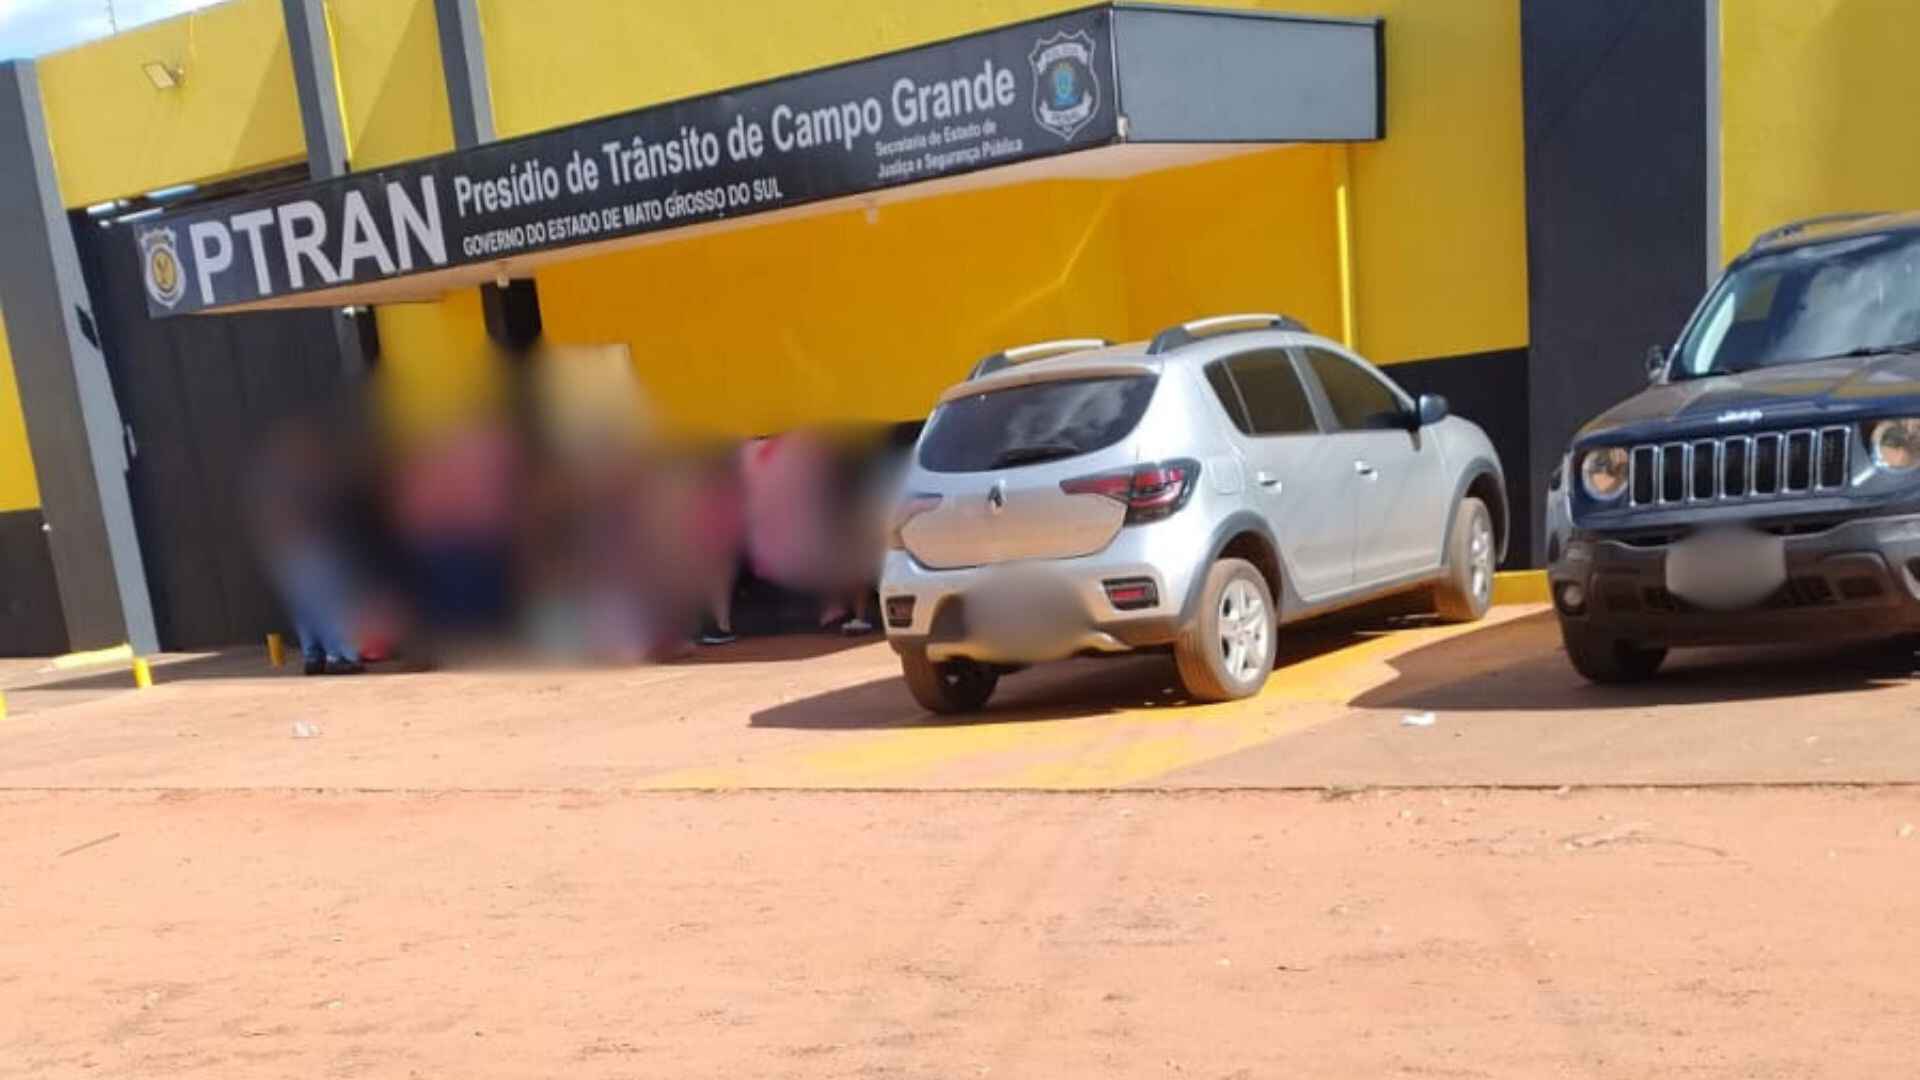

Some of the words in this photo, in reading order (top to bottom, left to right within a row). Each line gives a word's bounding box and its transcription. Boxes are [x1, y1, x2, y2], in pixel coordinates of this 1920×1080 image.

[454, 158, 560, 217] Presídio
[566, 147, 600, 194] de
[602, 125, 720, 186] Trânsito
[727, 114, 764, 162] de
[771, 97, 883, 150] Campo
[891, 59, 1017, 128] Grande
[927, 130, 942, 146] de
[943, 123, 981, 143] Estado
[982, 118, 997, 135] de
[189, 174, 448, 305] PTRAN
[462, 226, 525, 257] GOVERNO
[526, 221, 546, 244] DO
[547, 211, 600, 241] ESTADO
[601, 206, 622, 231] DE
[623, 199, 663, 225] MATO
[664, 187, 726, 219] GROSSO
[727, 182, 750, 206] DO
[752, 176, 784, 203] SUL
